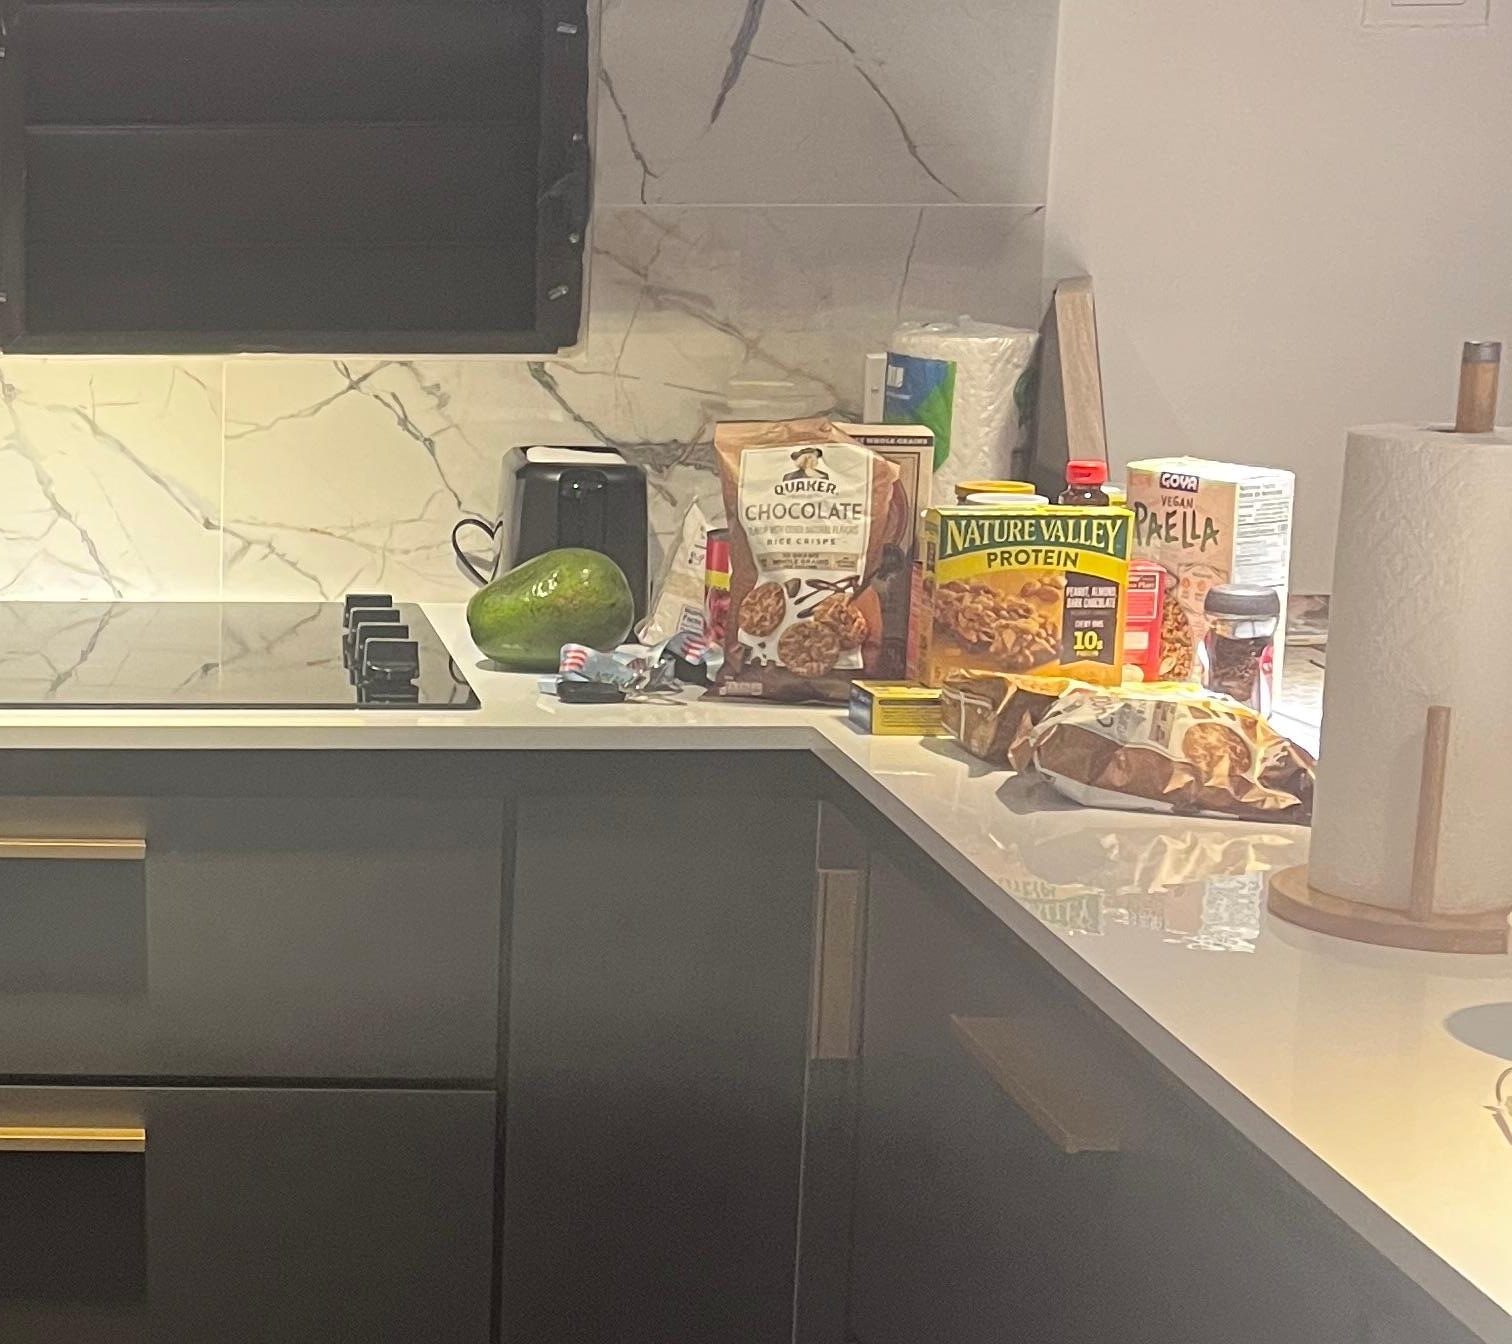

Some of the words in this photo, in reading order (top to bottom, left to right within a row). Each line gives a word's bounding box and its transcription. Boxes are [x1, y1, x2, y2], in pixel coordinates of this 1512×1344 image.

[774, 480, 838, 496] QUAKER
[1160, 471, 1199, 492] GOYA
[1160, 494, 1195, 508] VEGAN
[744, 502, 864, 522] CHOCOLATE
[944, 519, 1037, 555] NATURE
[1039, 519, 1123, 555] VALLEY
[1133, 501, 1220, 553] PAELLA
[766, 537, 793, 546] RICE
[986, 548, 1081, 569] PROTEIN
